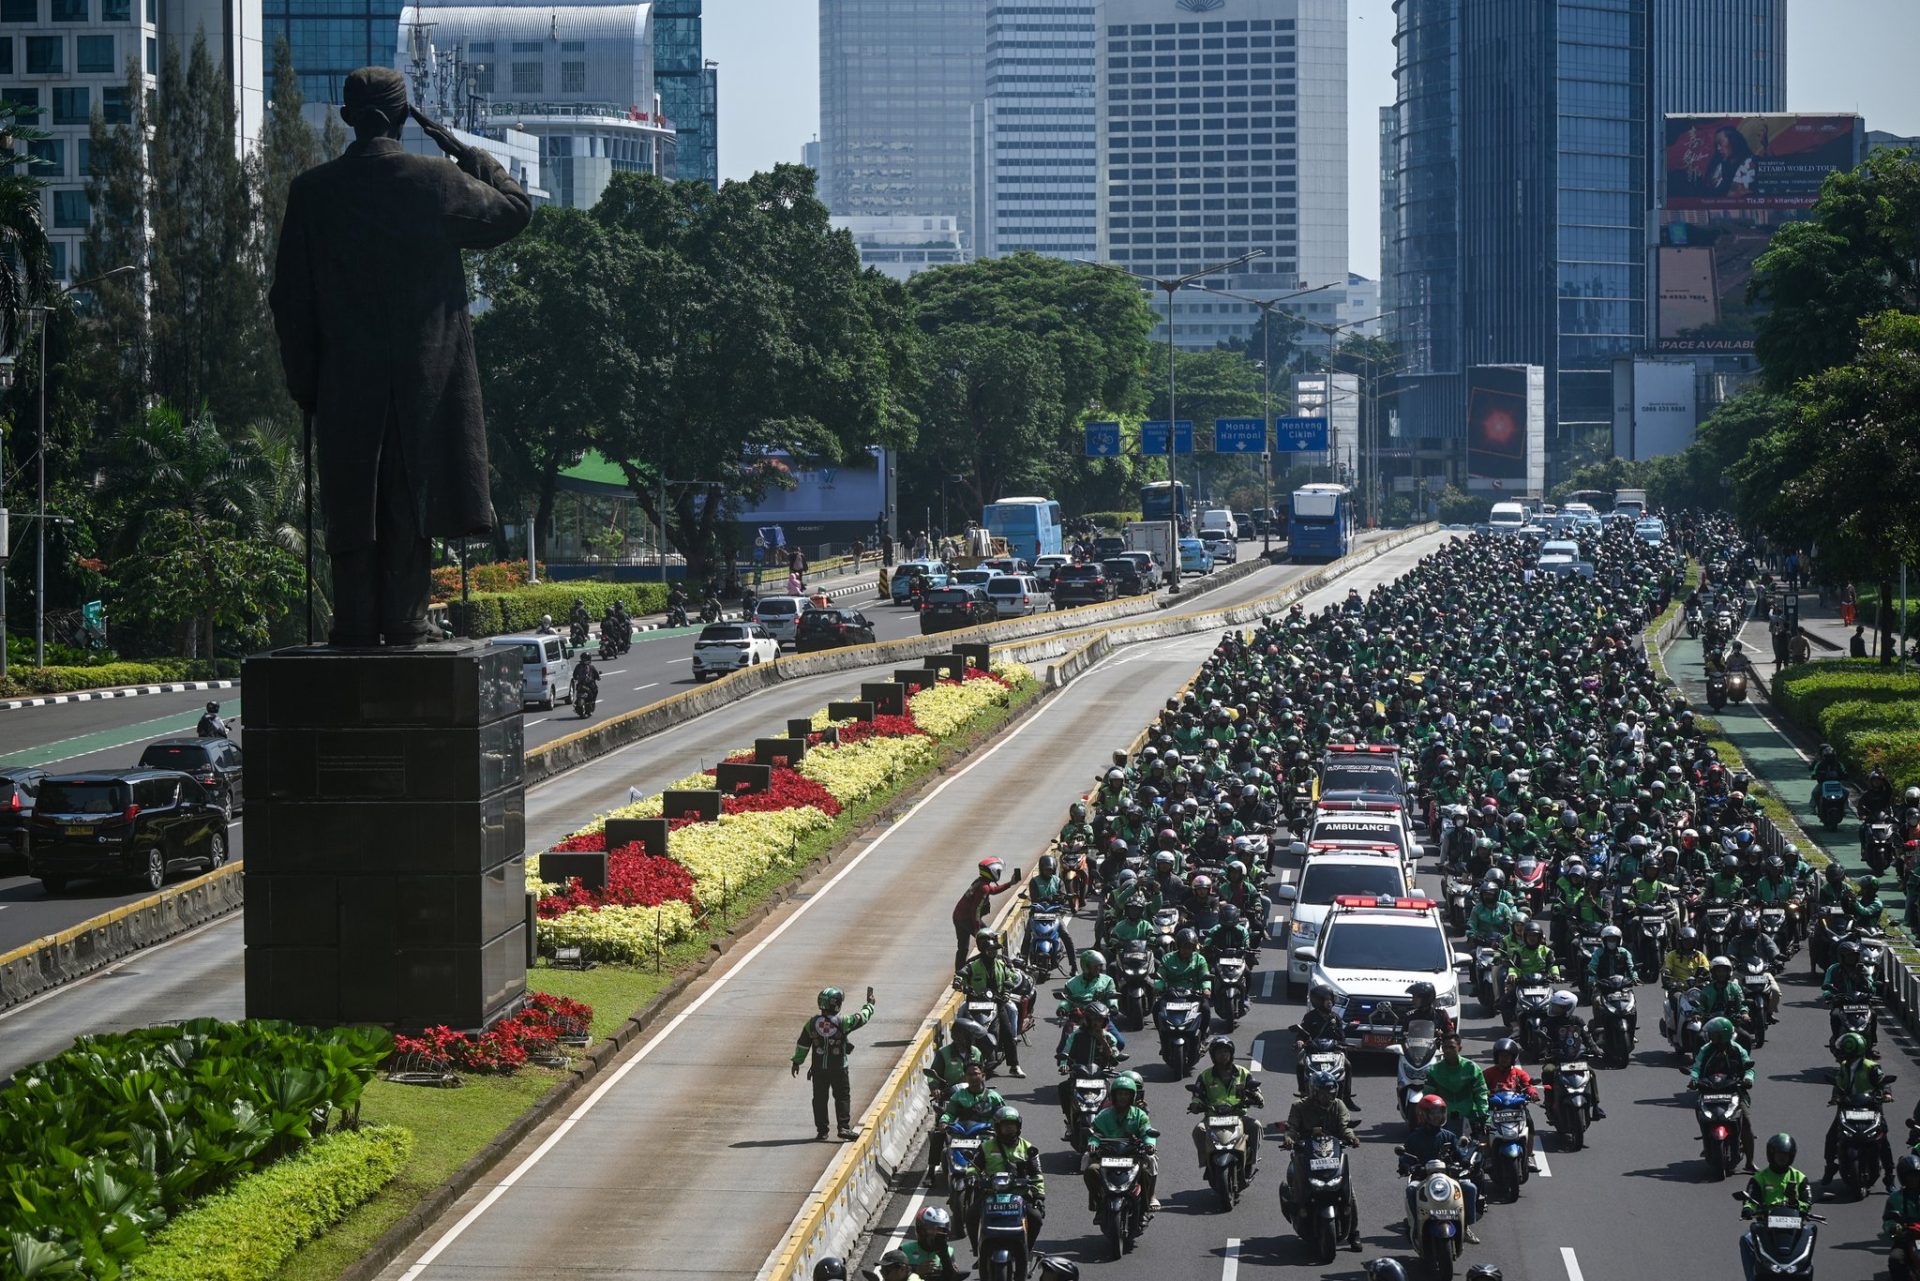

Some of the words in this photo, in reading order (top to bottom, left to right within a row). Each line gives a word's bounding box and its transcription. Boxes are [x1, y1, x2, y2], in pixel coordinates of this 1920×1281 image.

[492, 102, 553, 116] GREAT
[1659, 341, 1695, 349] PACE
[1696, 341, 1756, 349] AVAILABL
[1225, 423, 1257, 431] Monas
[1281, 422, 1322, 431] Menteng
[1221, 432, 1261, 440] Harmoni
[1288, 430, 1316, 439] Cikini
[1325, 823, 1391, 832] AMBULANCE
